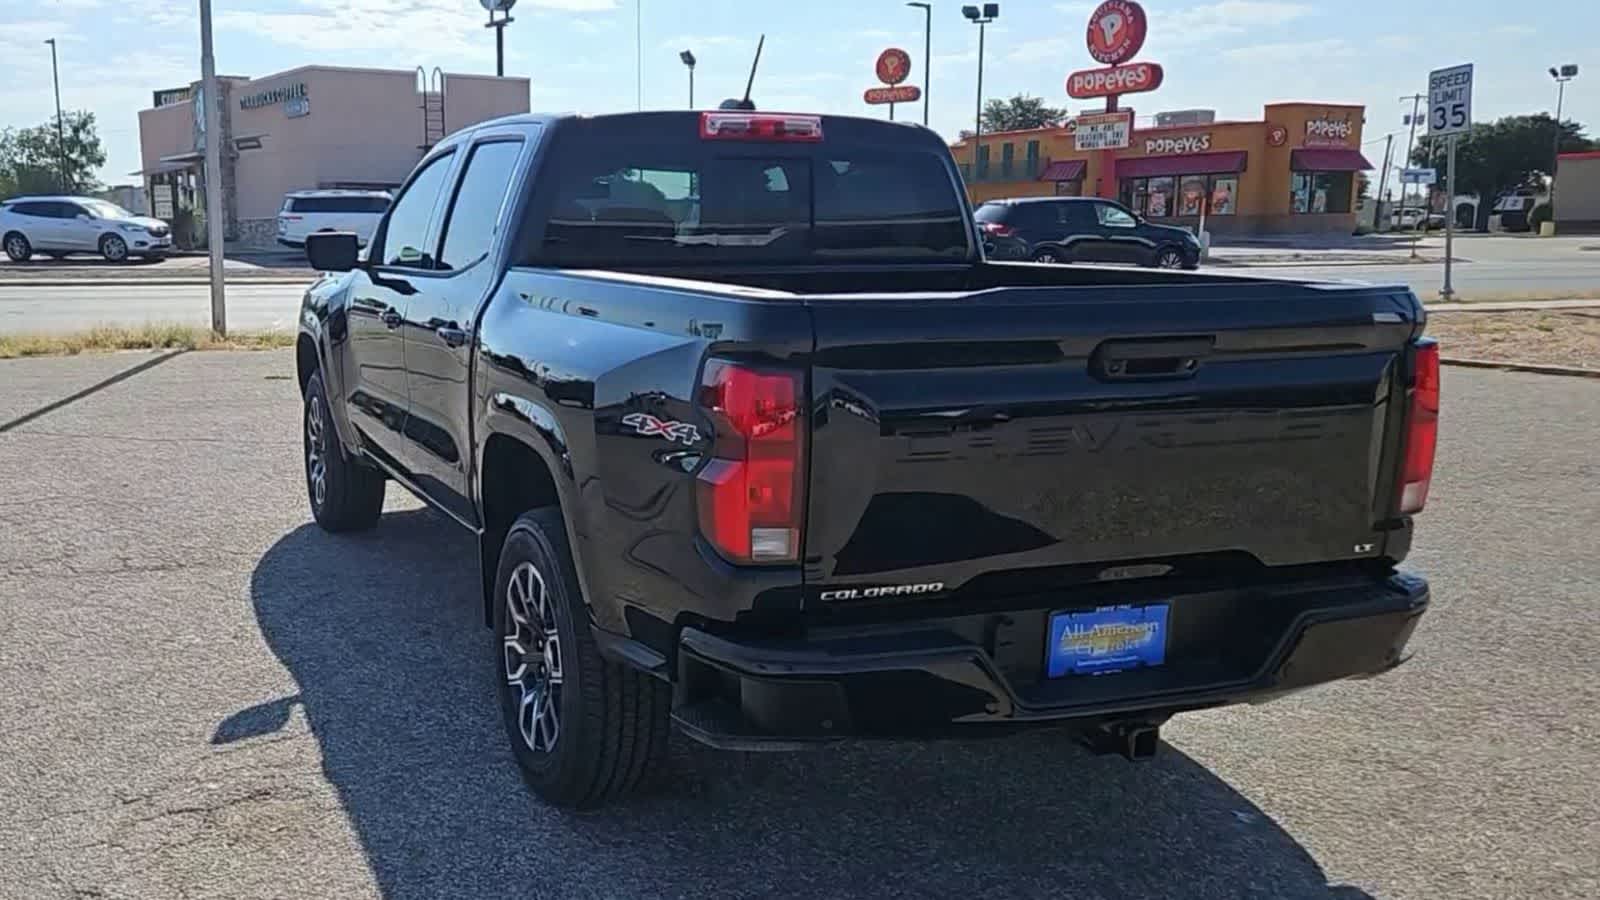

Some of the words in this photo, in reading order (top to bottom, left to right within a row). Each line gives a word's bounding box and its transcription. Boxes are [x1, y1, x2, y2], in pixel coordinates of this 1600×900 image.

[1099, 13, 1122, 47] P
[1431, 71, 1470, 90] SPEED
[1434, 87, 1464, 104] LIMIT
[1433, 104, 1466, 130] 35
[1354, 543, 1375, 553] LT
[820, 581, 945, 601] COLORADO
